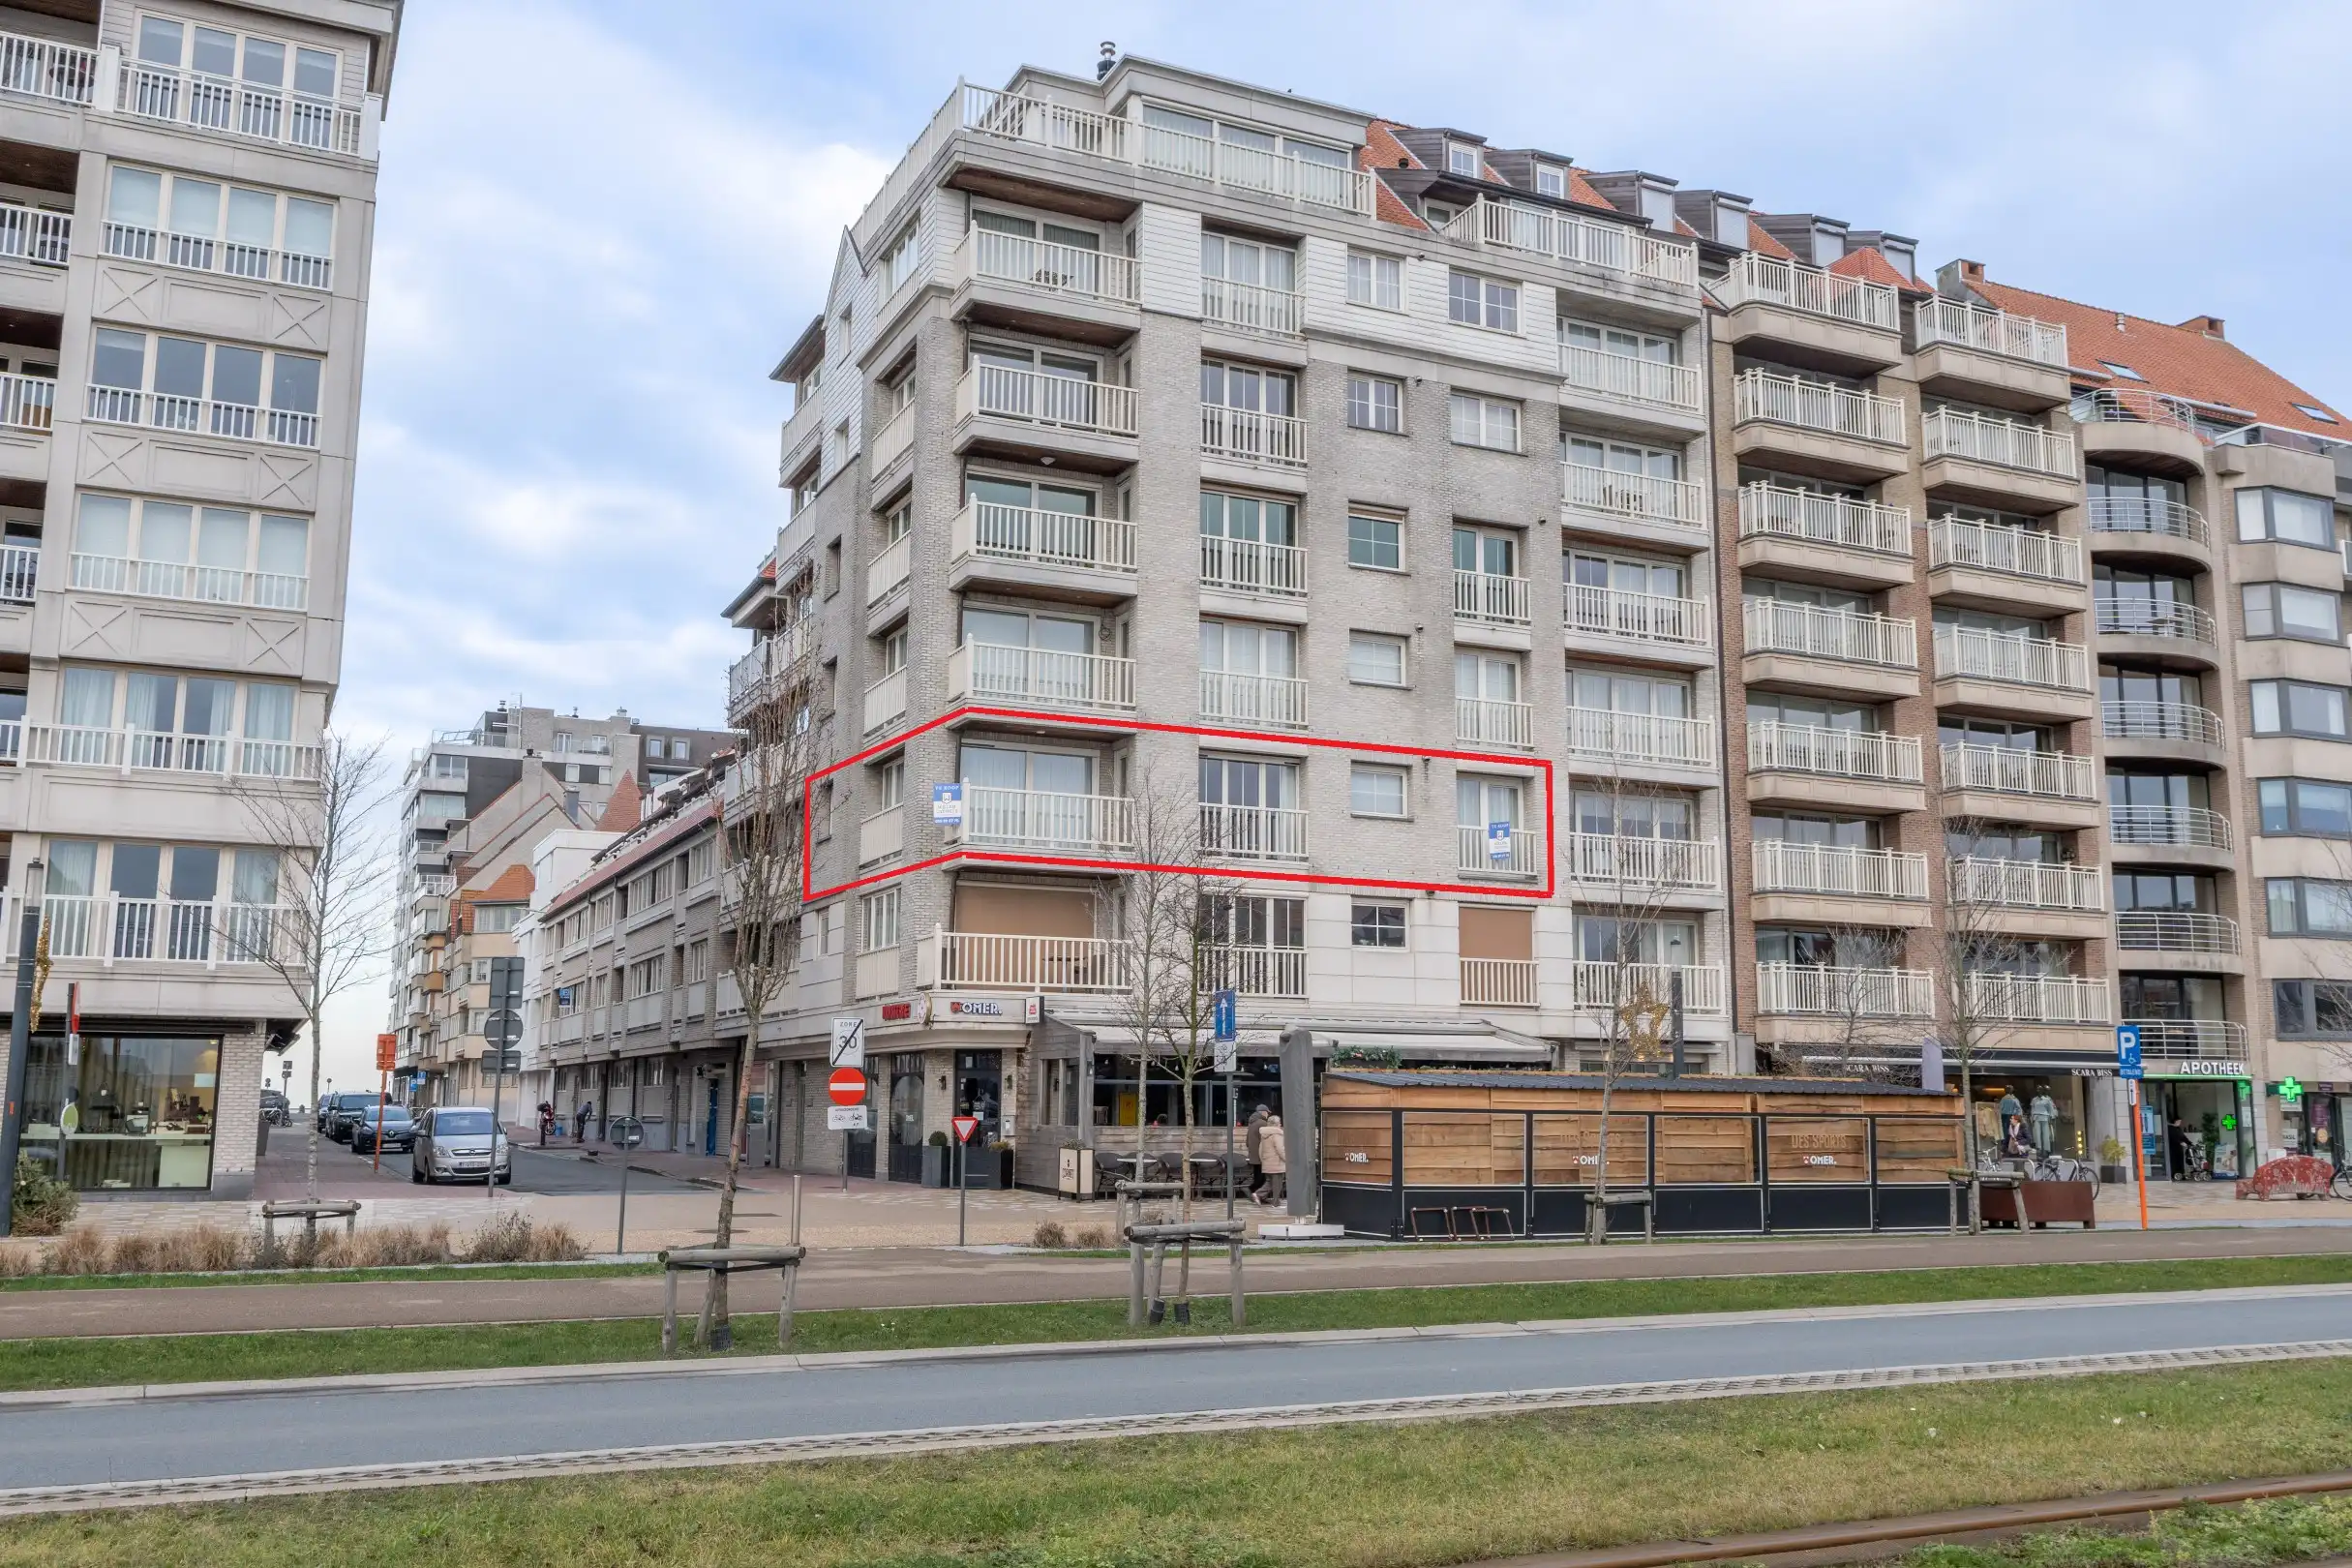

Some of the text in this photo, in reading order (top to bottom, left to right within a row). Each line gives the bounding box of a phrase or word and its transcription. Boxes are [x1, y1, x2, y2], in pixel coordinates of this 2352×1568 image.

[961, 1001, 1003, 1015] OMER.
[838, 1035, 858, 1049] 30
[2120, 1032, 2135, 1059] P
[2180, 1061, 2245, 1074] APOTHEEK
[1812, 1133, 1847, 1149] SPORTS
[1349, 1152, 1369, 1163] OMER.
[1809, 1155, 1837, 1165] OMER.
